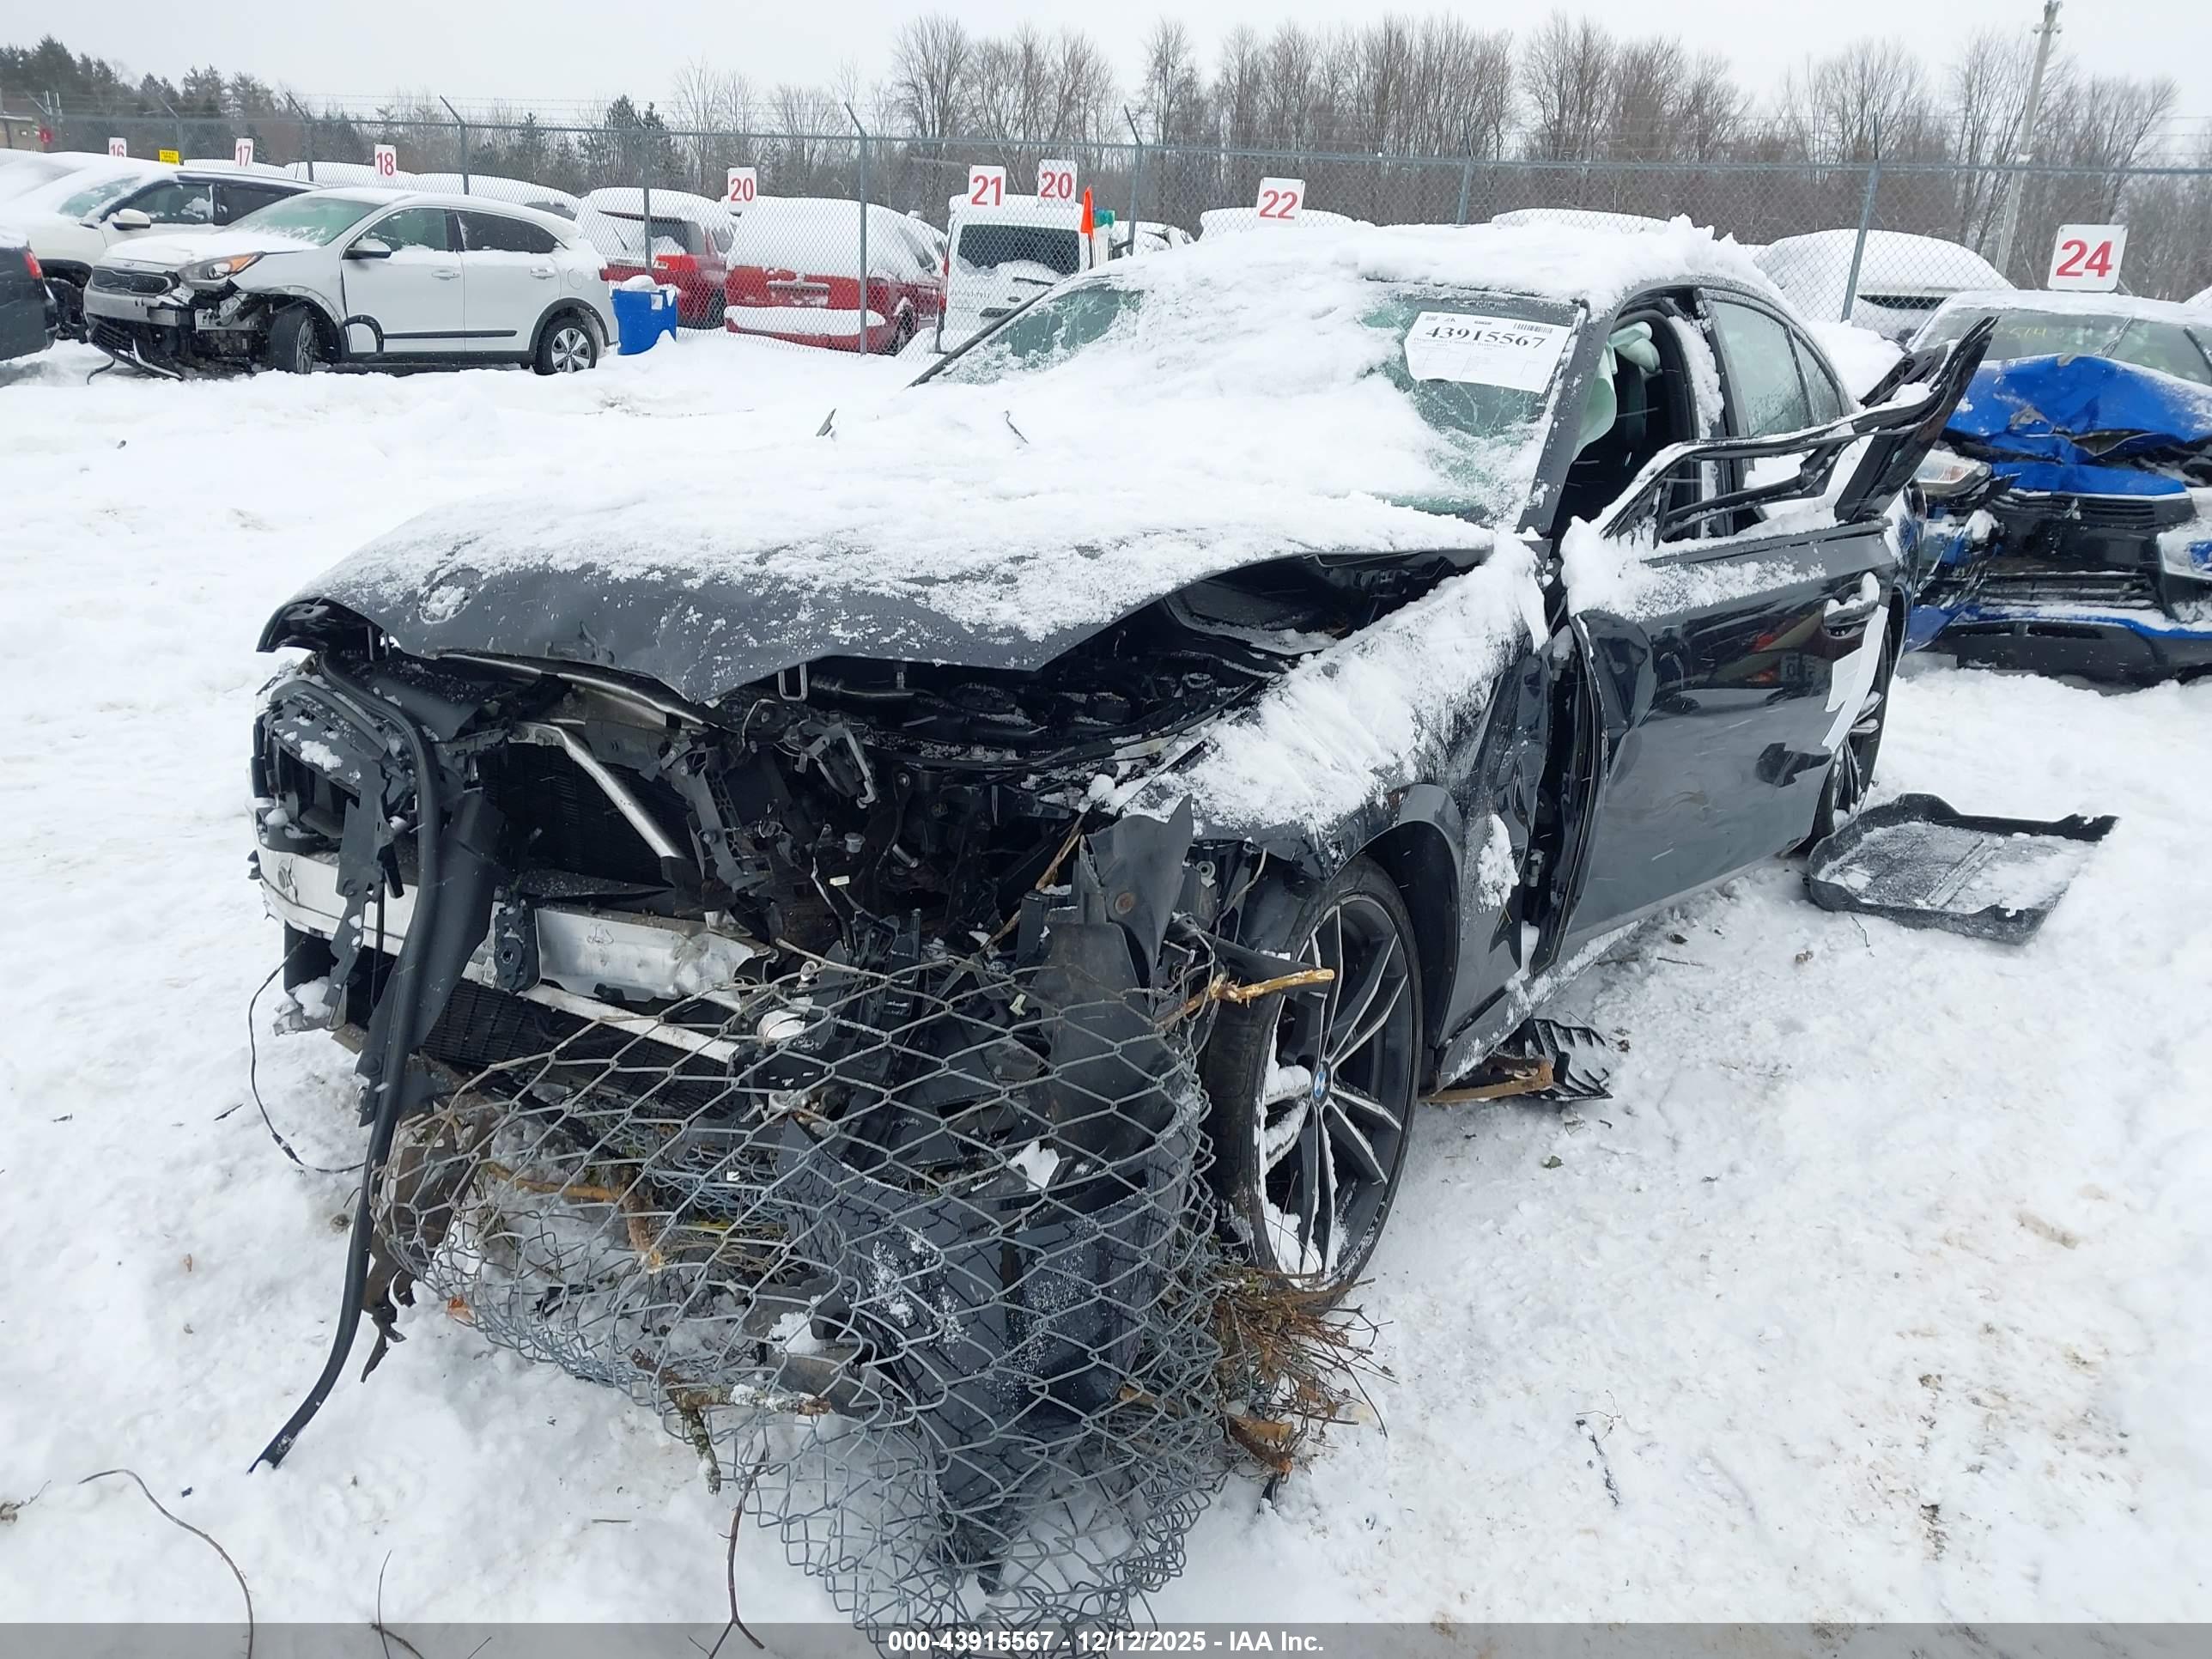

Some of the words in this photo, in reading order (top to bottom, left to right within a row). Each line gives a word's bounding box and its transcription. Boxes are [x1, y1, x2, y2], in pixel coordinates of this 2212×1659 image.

[110, 144, 125, 156] 16
[237, 145, 251, 167] 17
[377, 152, 394, 176] 18
[729, 178, 756, 204] 20
[971, 175, 1002, 206] 21
[1039, 170, 1073, 201] 20
[1258, 188, 1299, 221] 22
[2055, 238, 2114, 279] 24
[1425, 326, 1547, 349] 43915567
